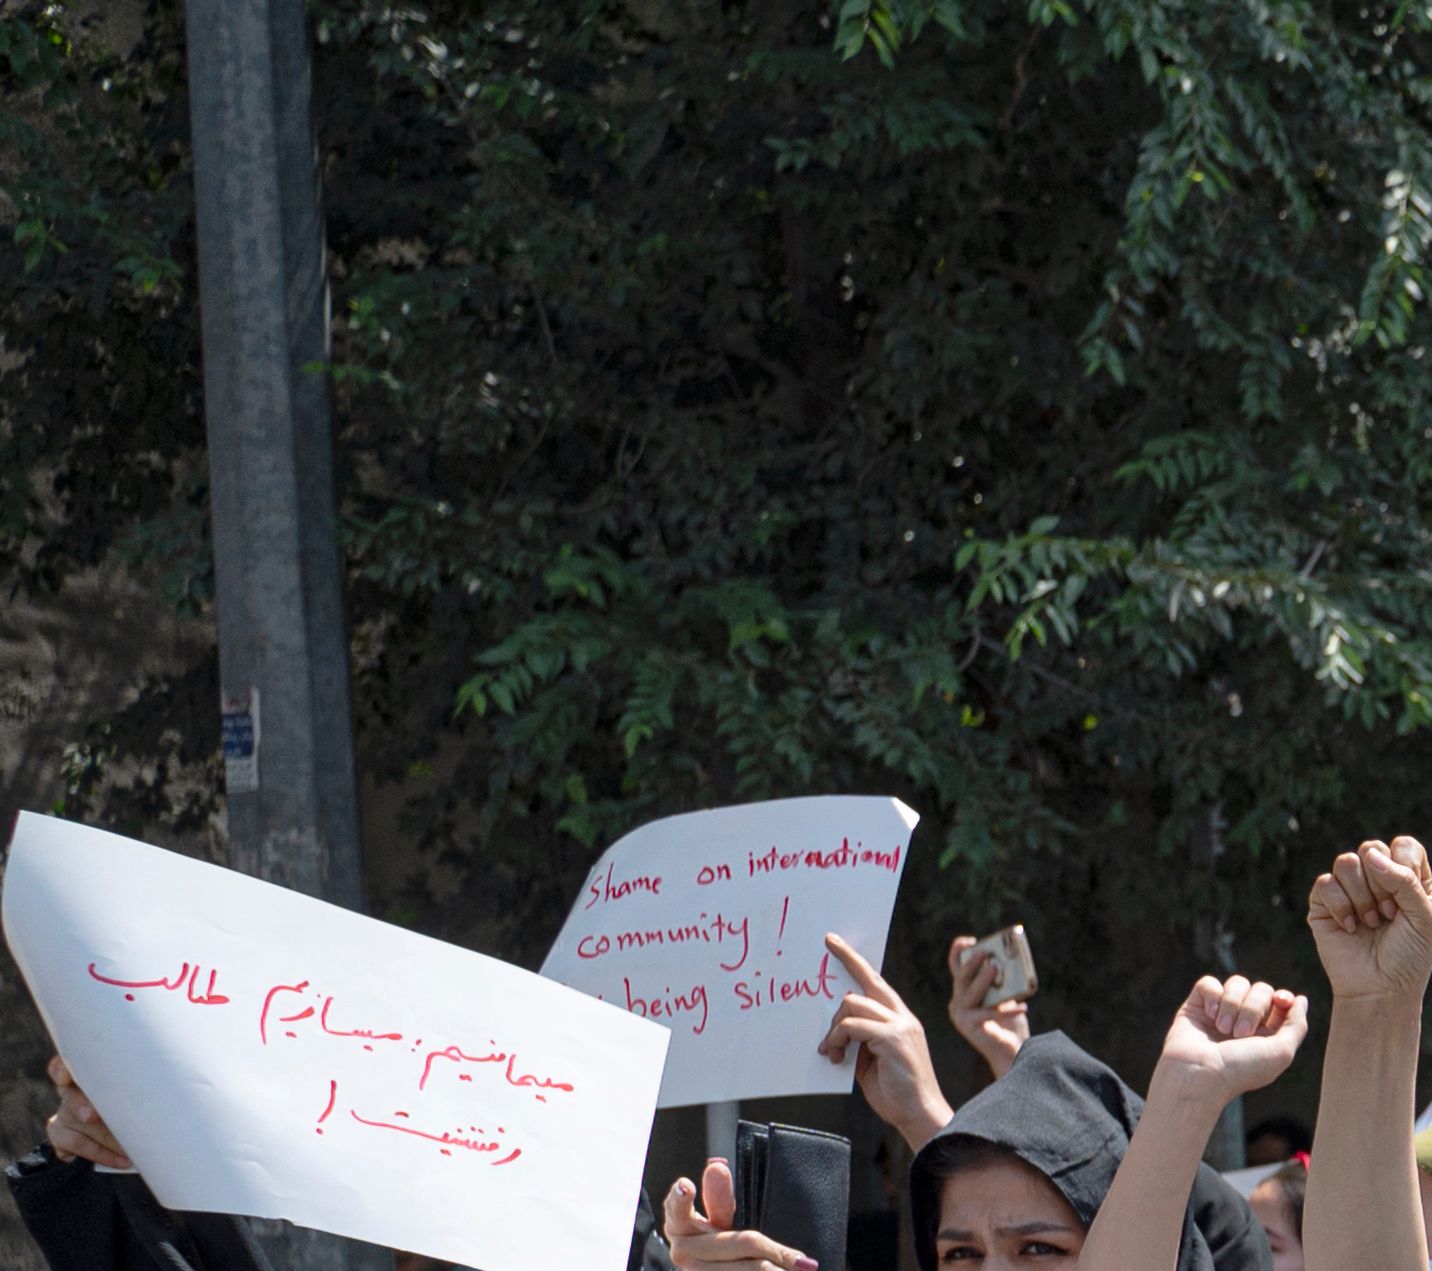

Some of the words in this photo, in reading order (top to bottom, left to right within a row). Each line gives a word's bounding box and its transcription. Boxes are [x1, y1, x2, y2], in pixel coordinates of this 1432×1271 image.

[697, 862, 732, 886] on
[748, 836, 901, 874] international
[88, 962, 230, 1005] طالب
